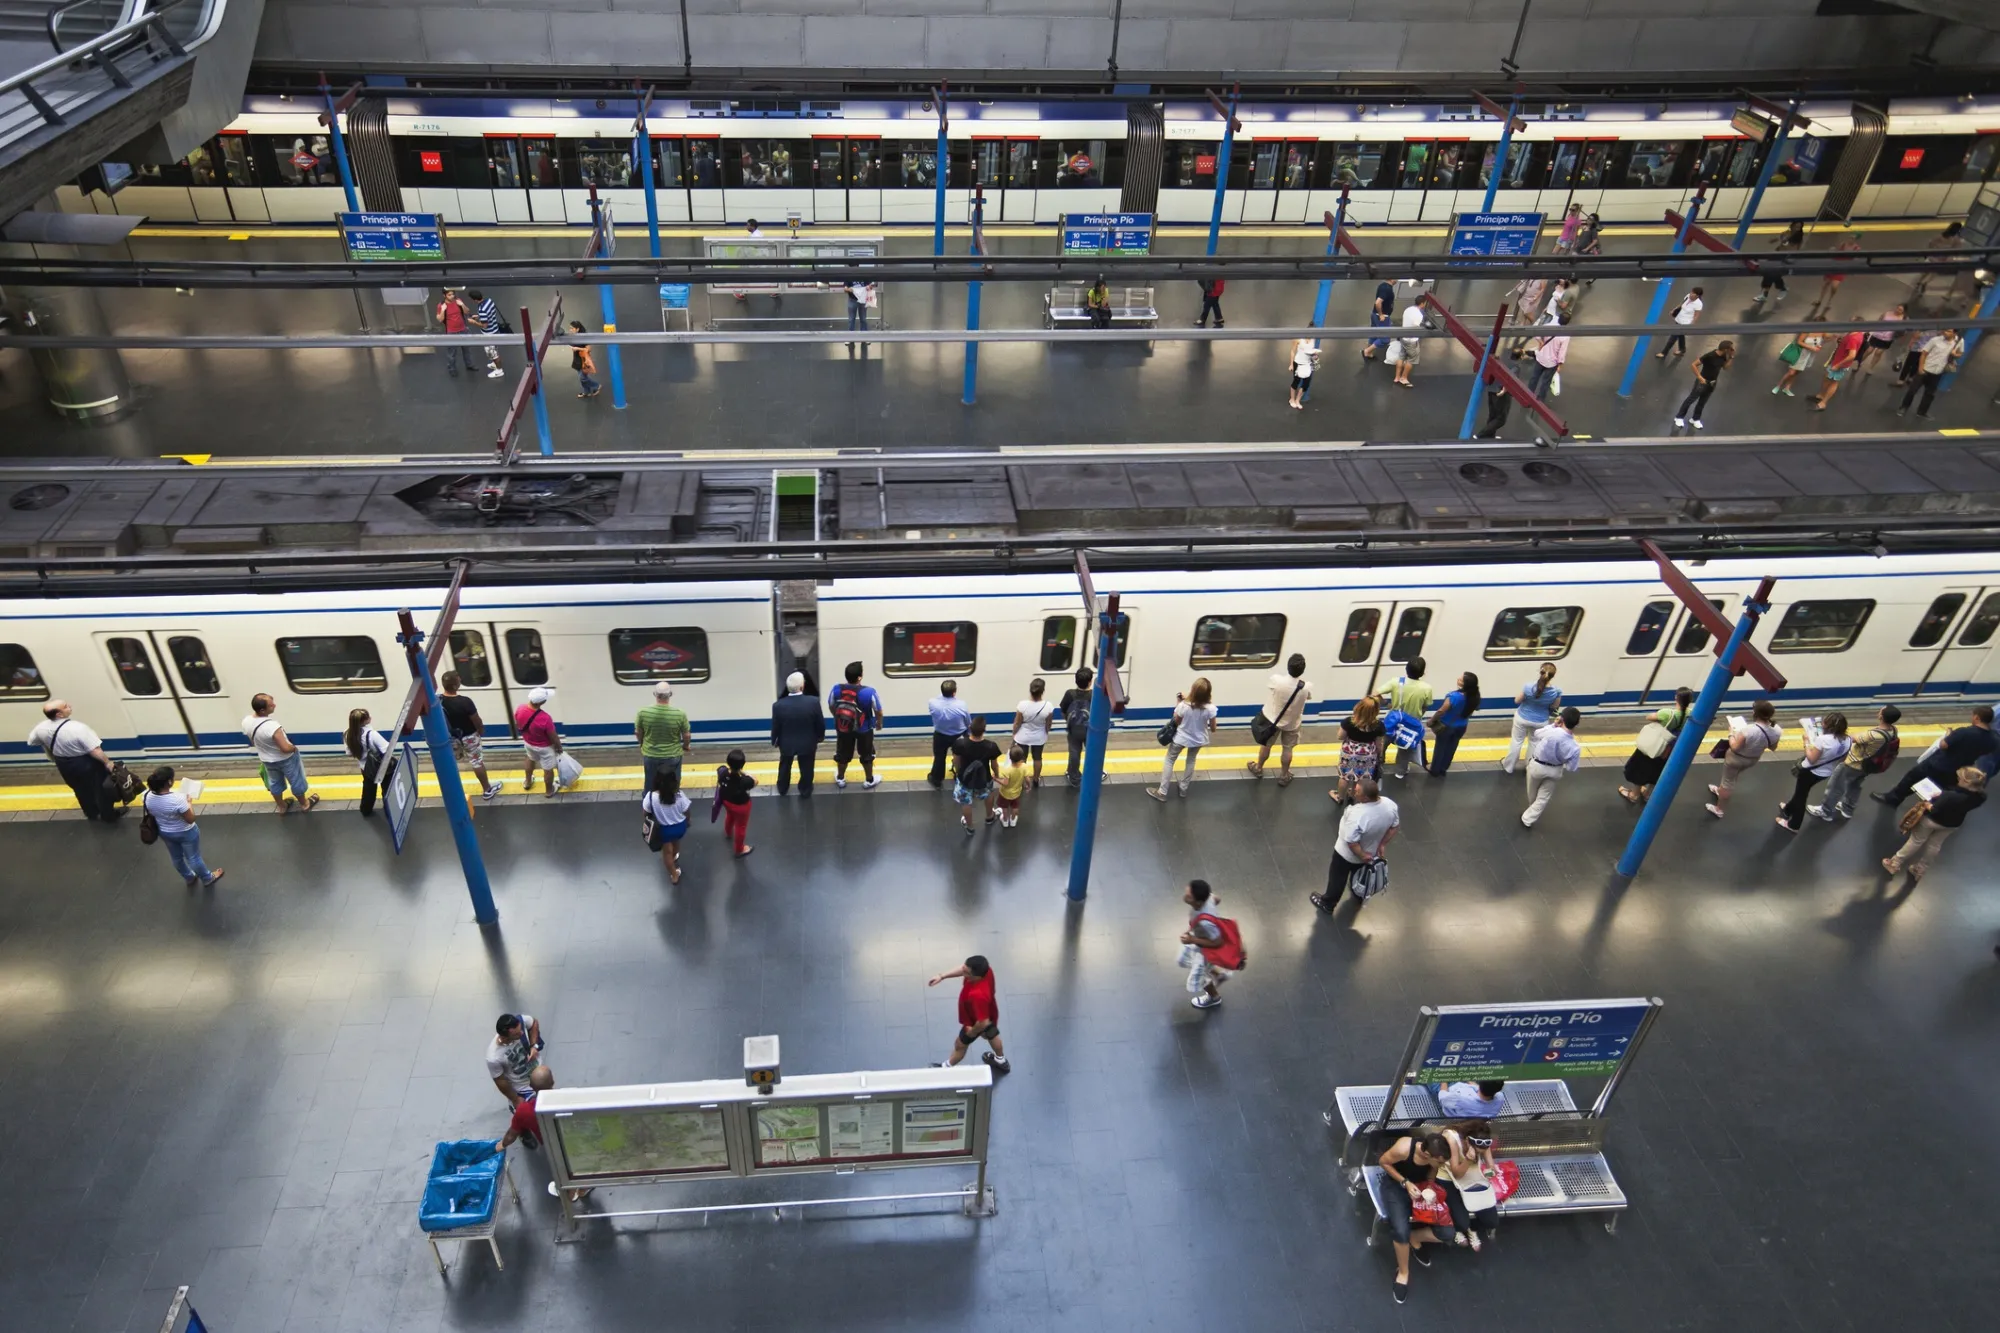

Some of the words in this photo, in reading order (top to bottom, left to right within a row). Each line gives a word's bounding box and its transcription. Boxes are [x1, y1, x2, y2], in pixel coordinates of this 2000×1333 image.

[1804, 138, 1821, 158] 10
[361, 215, 399, 225] Príncipe
[400, 215, 417, 225] Pío
[1120, 215, 1134, 224] Pío
[1474, 215, 1510, 225] Príncipe
[1510, 215, 1526, 224] Pío
[394, 772, 406, 810] 6
[1480, 1013, 1562, 1028] Príncipe
[1568, 1011, 1602, 1024] Pío
[1512, 1030, 1549, 1038] Andén
[1450, 1042, 1461, 1051] 6
[1552, 1038, 1564, 1047] 6
[1444, 1055, 1457, 1065] R
